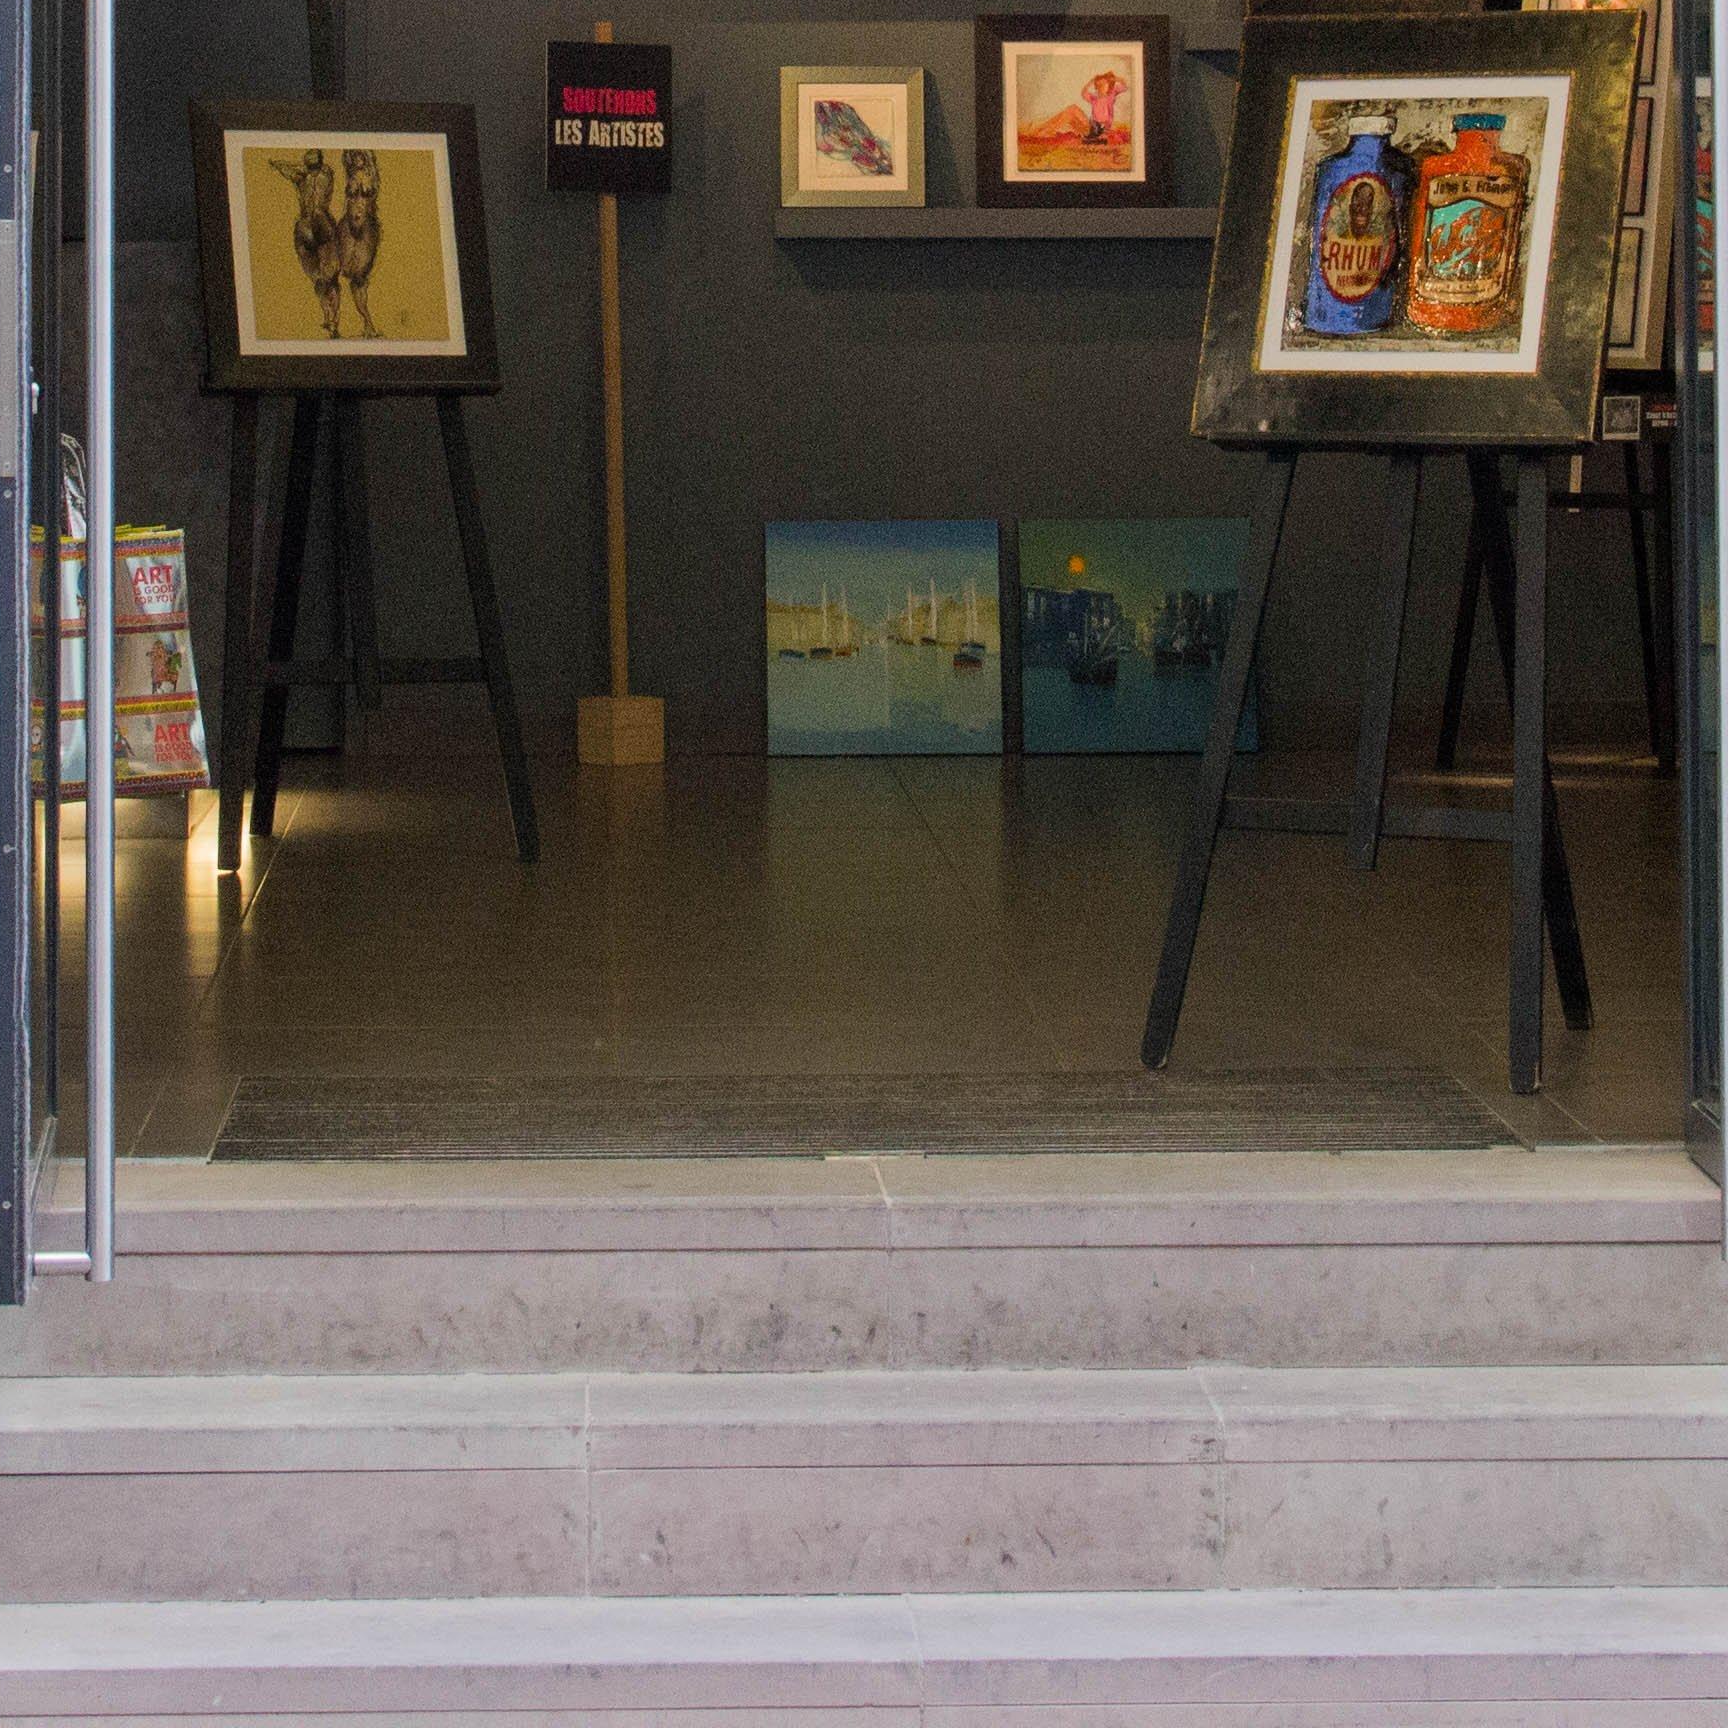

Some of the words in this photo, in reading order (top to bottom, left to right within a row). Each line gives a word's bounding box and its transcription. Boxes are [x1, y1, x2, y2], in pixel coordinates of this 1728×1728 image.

[563, 86, 657, 115] SOUTENONS
[555, 119, 583, 147] LES
[588, 119, 665, 148] ARTISTES
[132, 564, 173, 585] ART
[155, 723, 191, 743] ART
